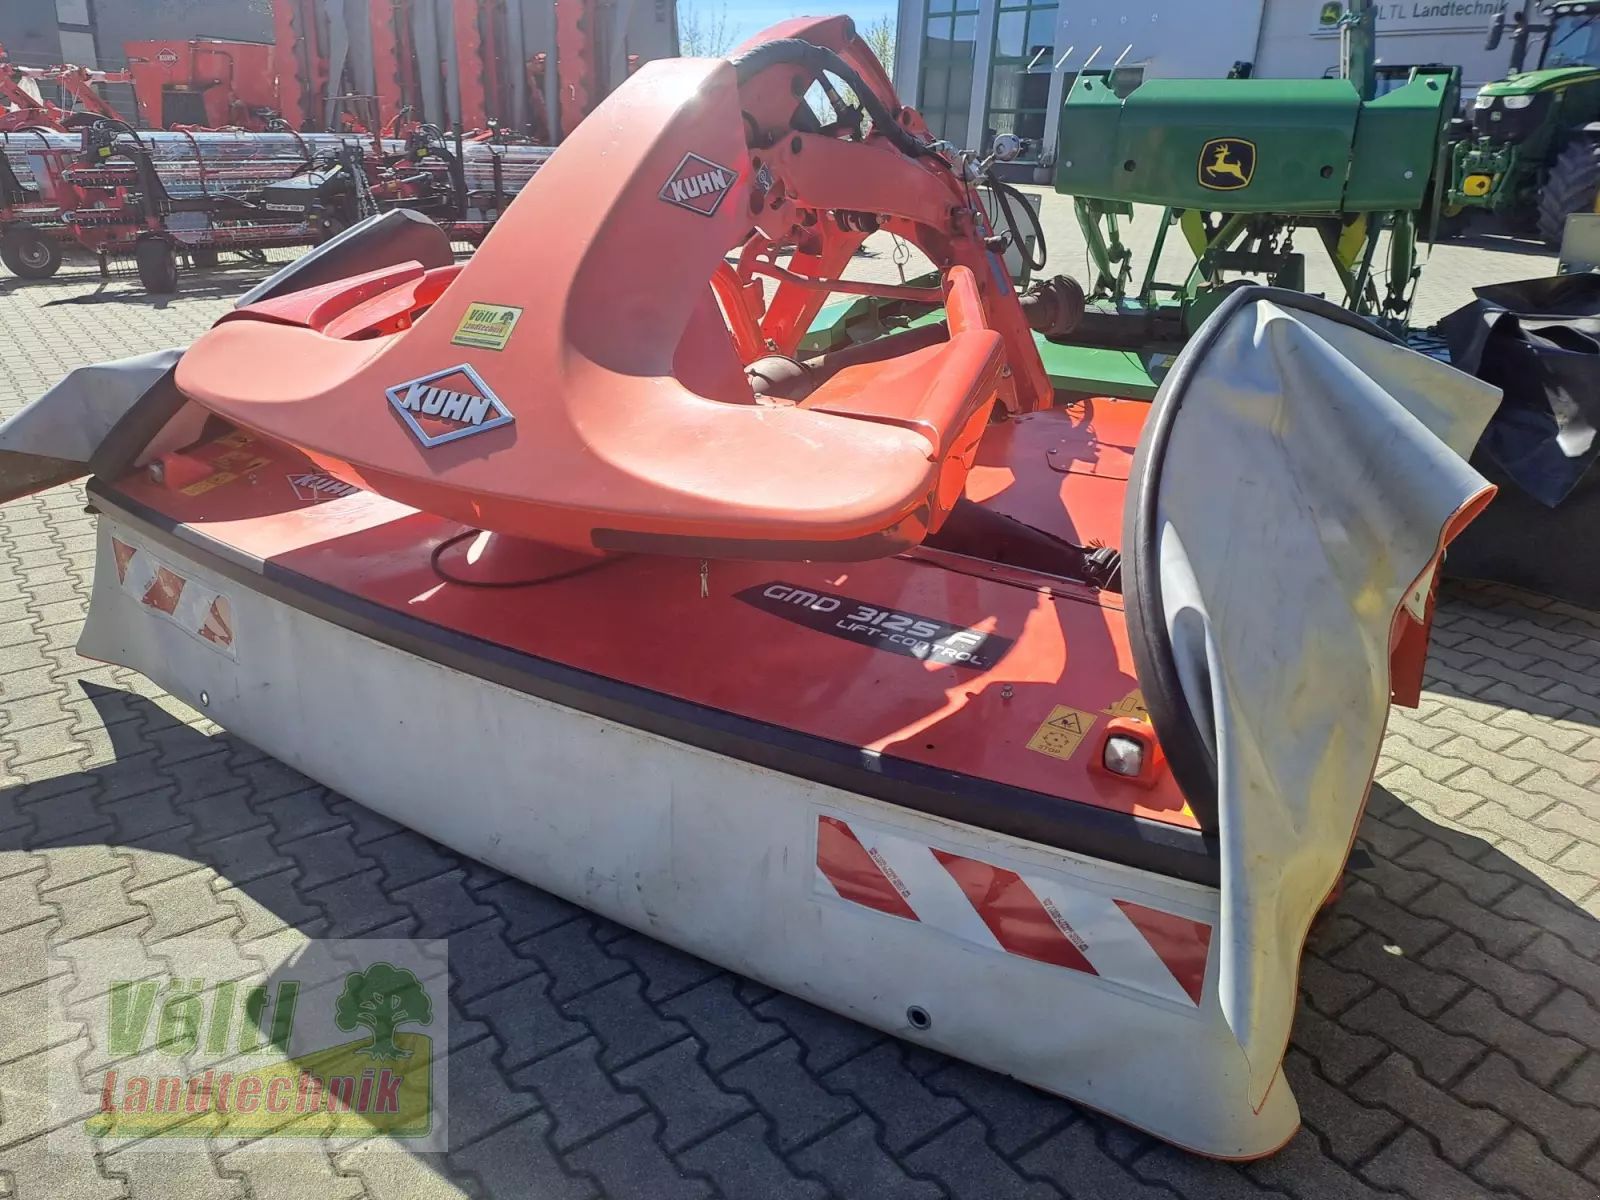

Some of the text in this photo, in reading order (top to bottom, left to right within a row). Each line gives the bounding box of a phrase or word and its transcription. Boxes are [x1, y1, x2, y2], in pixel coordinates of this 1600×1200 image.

[1412, 1, 1509, 18] Landtechnik
[670, 169, 727, 202] KUHN
[402, 382, 492, 425] KUHN
[294, 474, 360, 497] KUHN
[763, 584, 981, 646] GMD 3125 F
[836, 618, 986, 665] LIFT-CONTROL
